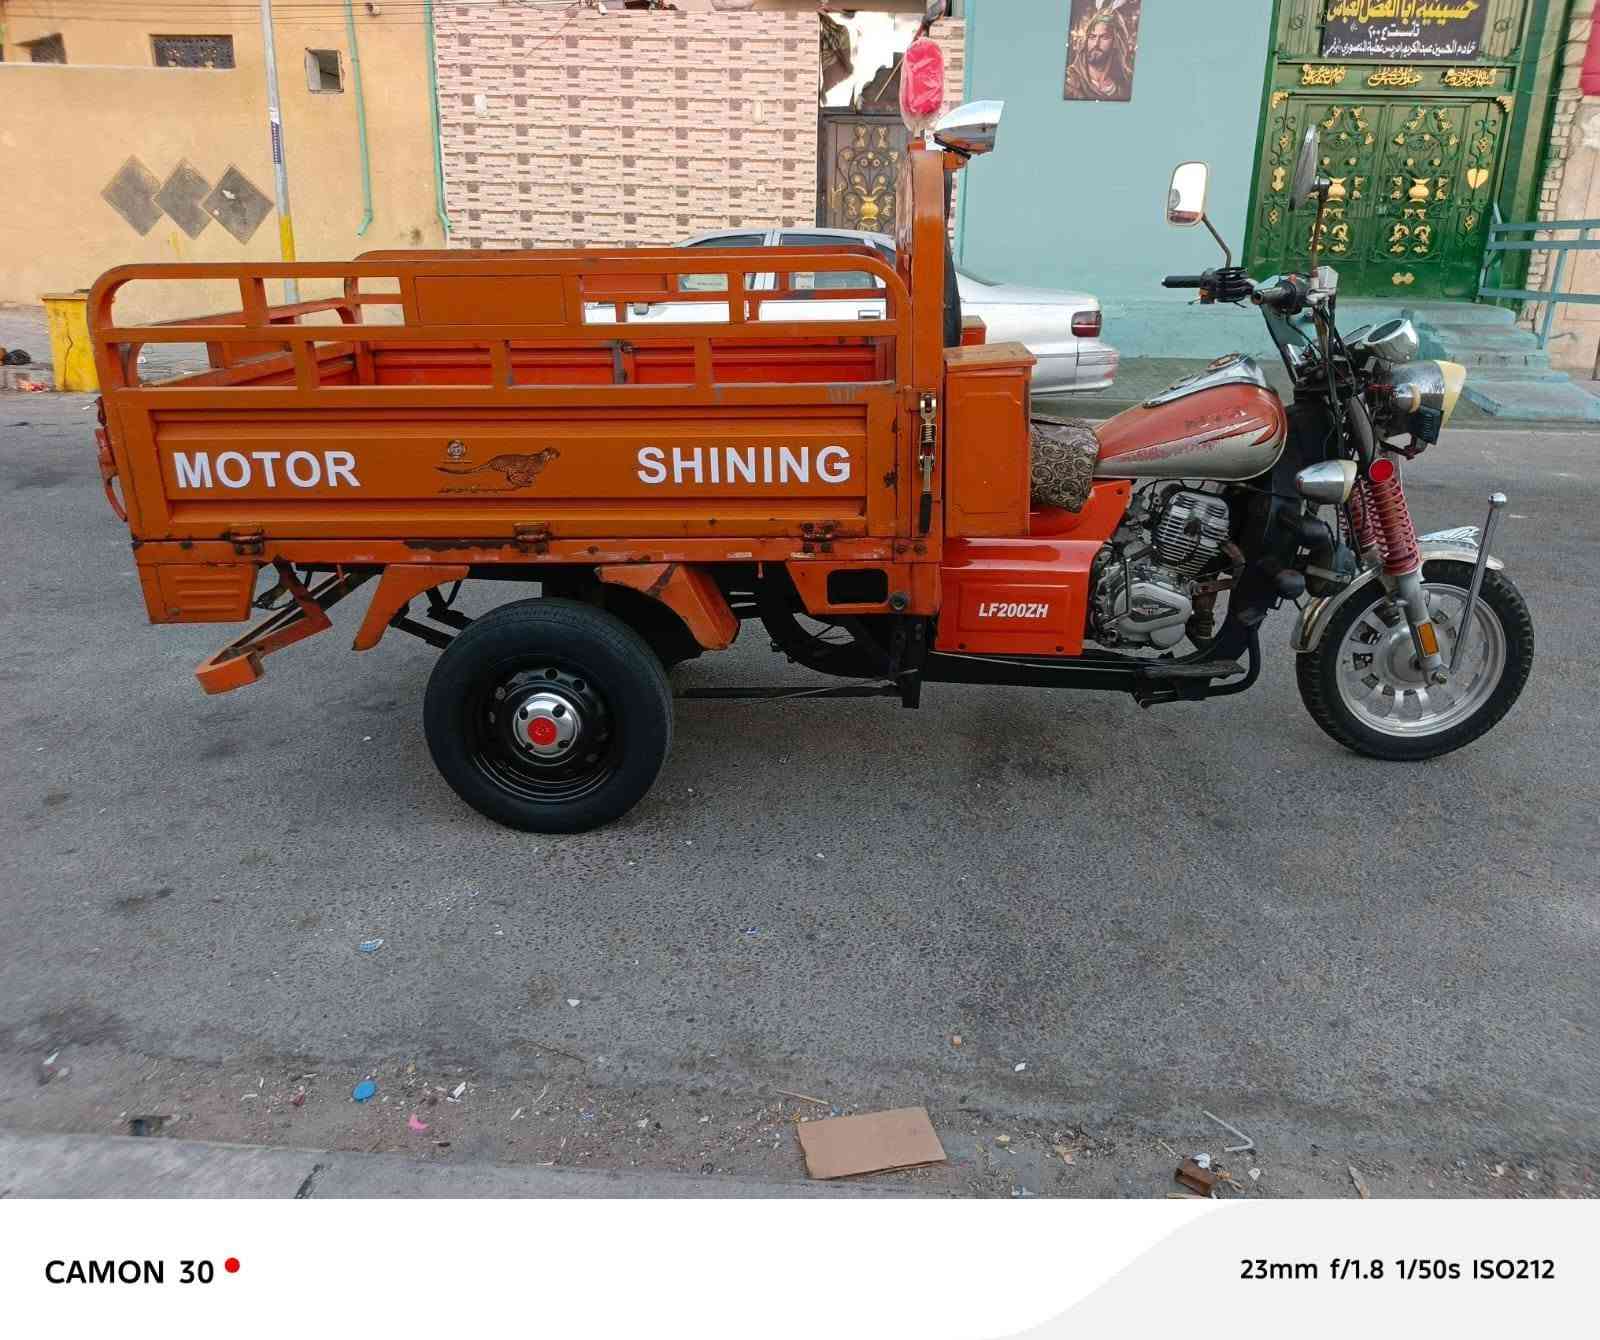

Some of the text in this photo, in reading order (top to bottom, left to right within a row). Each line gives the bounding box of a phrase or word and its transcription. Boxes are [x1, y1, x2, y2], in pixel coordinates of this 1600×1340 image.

[173, 445, 851, 488] MOTOR SHINING
[978, 602, 1049, 618] LF200ZH
